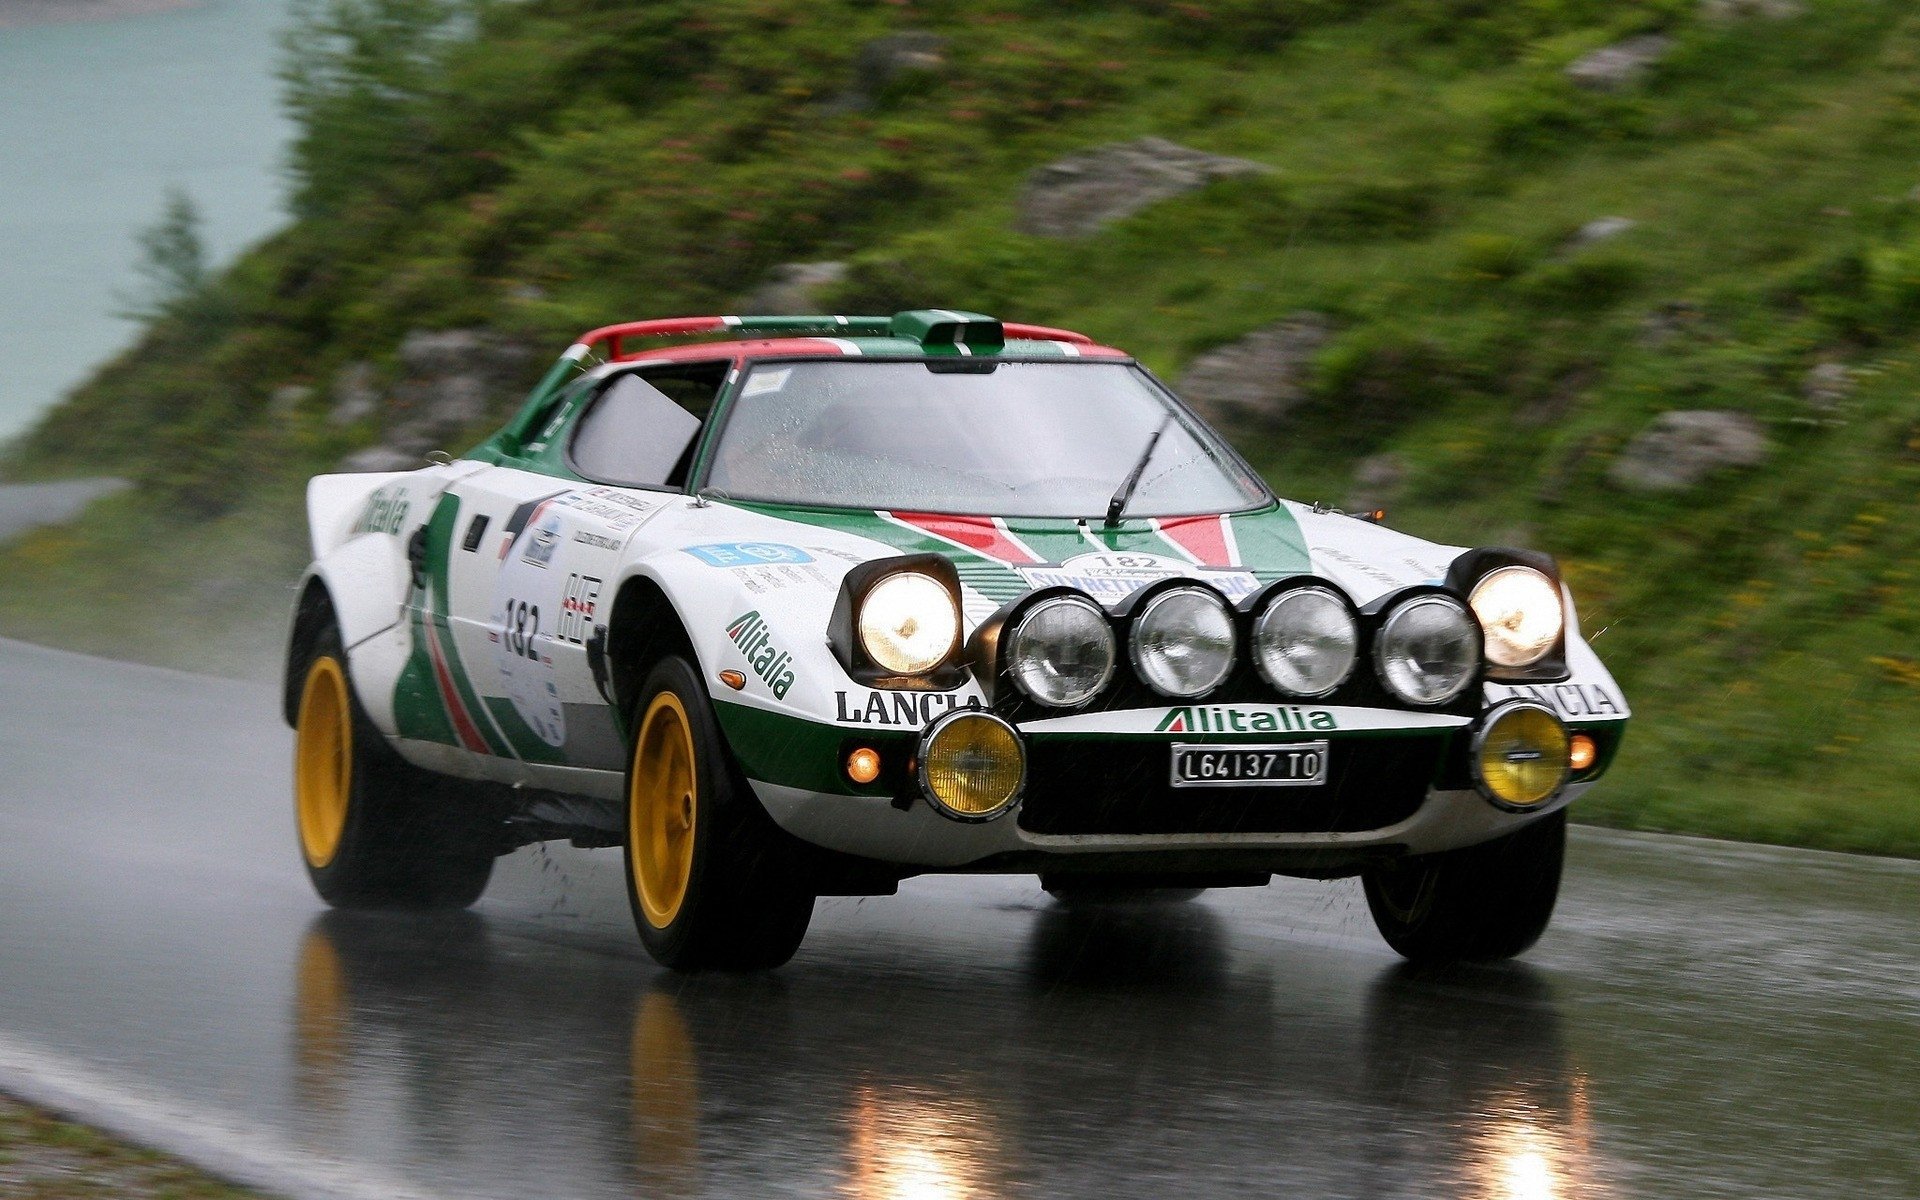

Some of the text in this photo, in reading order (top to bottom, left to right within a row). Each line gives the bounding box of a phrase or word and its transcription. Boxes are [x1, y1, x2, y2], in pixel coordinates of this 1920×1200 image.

[1095, 556, 1163, 568] 182
[504, 597, 539, 662] 182
[726, 610, 795, 701] Alitalia
[1484, 684, 1621, 716] NCIA
[1154, 706, 1338, 732] Alitalia
[1185, 752, 1319, 779] L64137 TO
